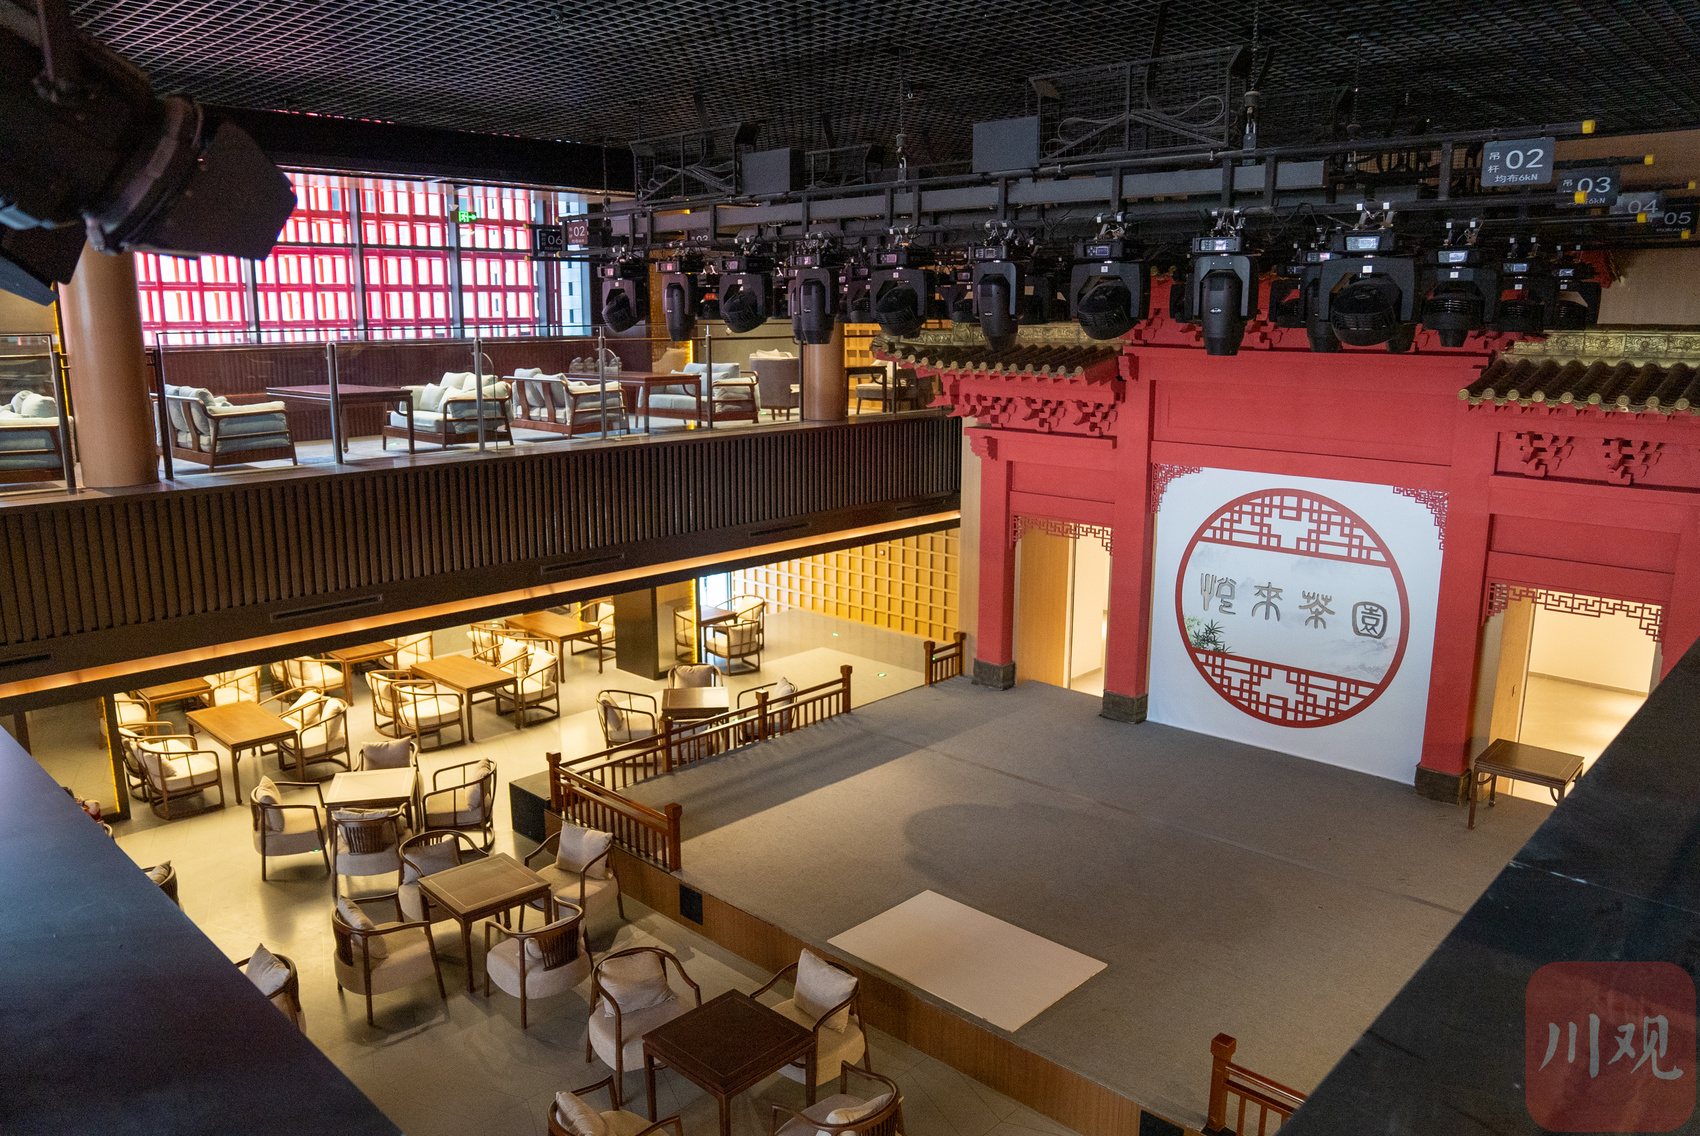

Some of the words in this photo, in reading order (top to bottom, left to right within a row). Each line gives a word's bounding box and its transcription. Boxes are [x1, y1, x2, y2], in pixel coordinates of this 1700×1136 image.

[1505, 148, 1544, 169] 02
[1494, 173, 1538, 183] 均布6kN
[1577, 176, 1611, 193] 03
[1627, 199, 1659, 214] 04
[1664, 211, 1692, 225] 05
[573, 225, 585, 237] 02
[547, 235, 563, 245] 06
